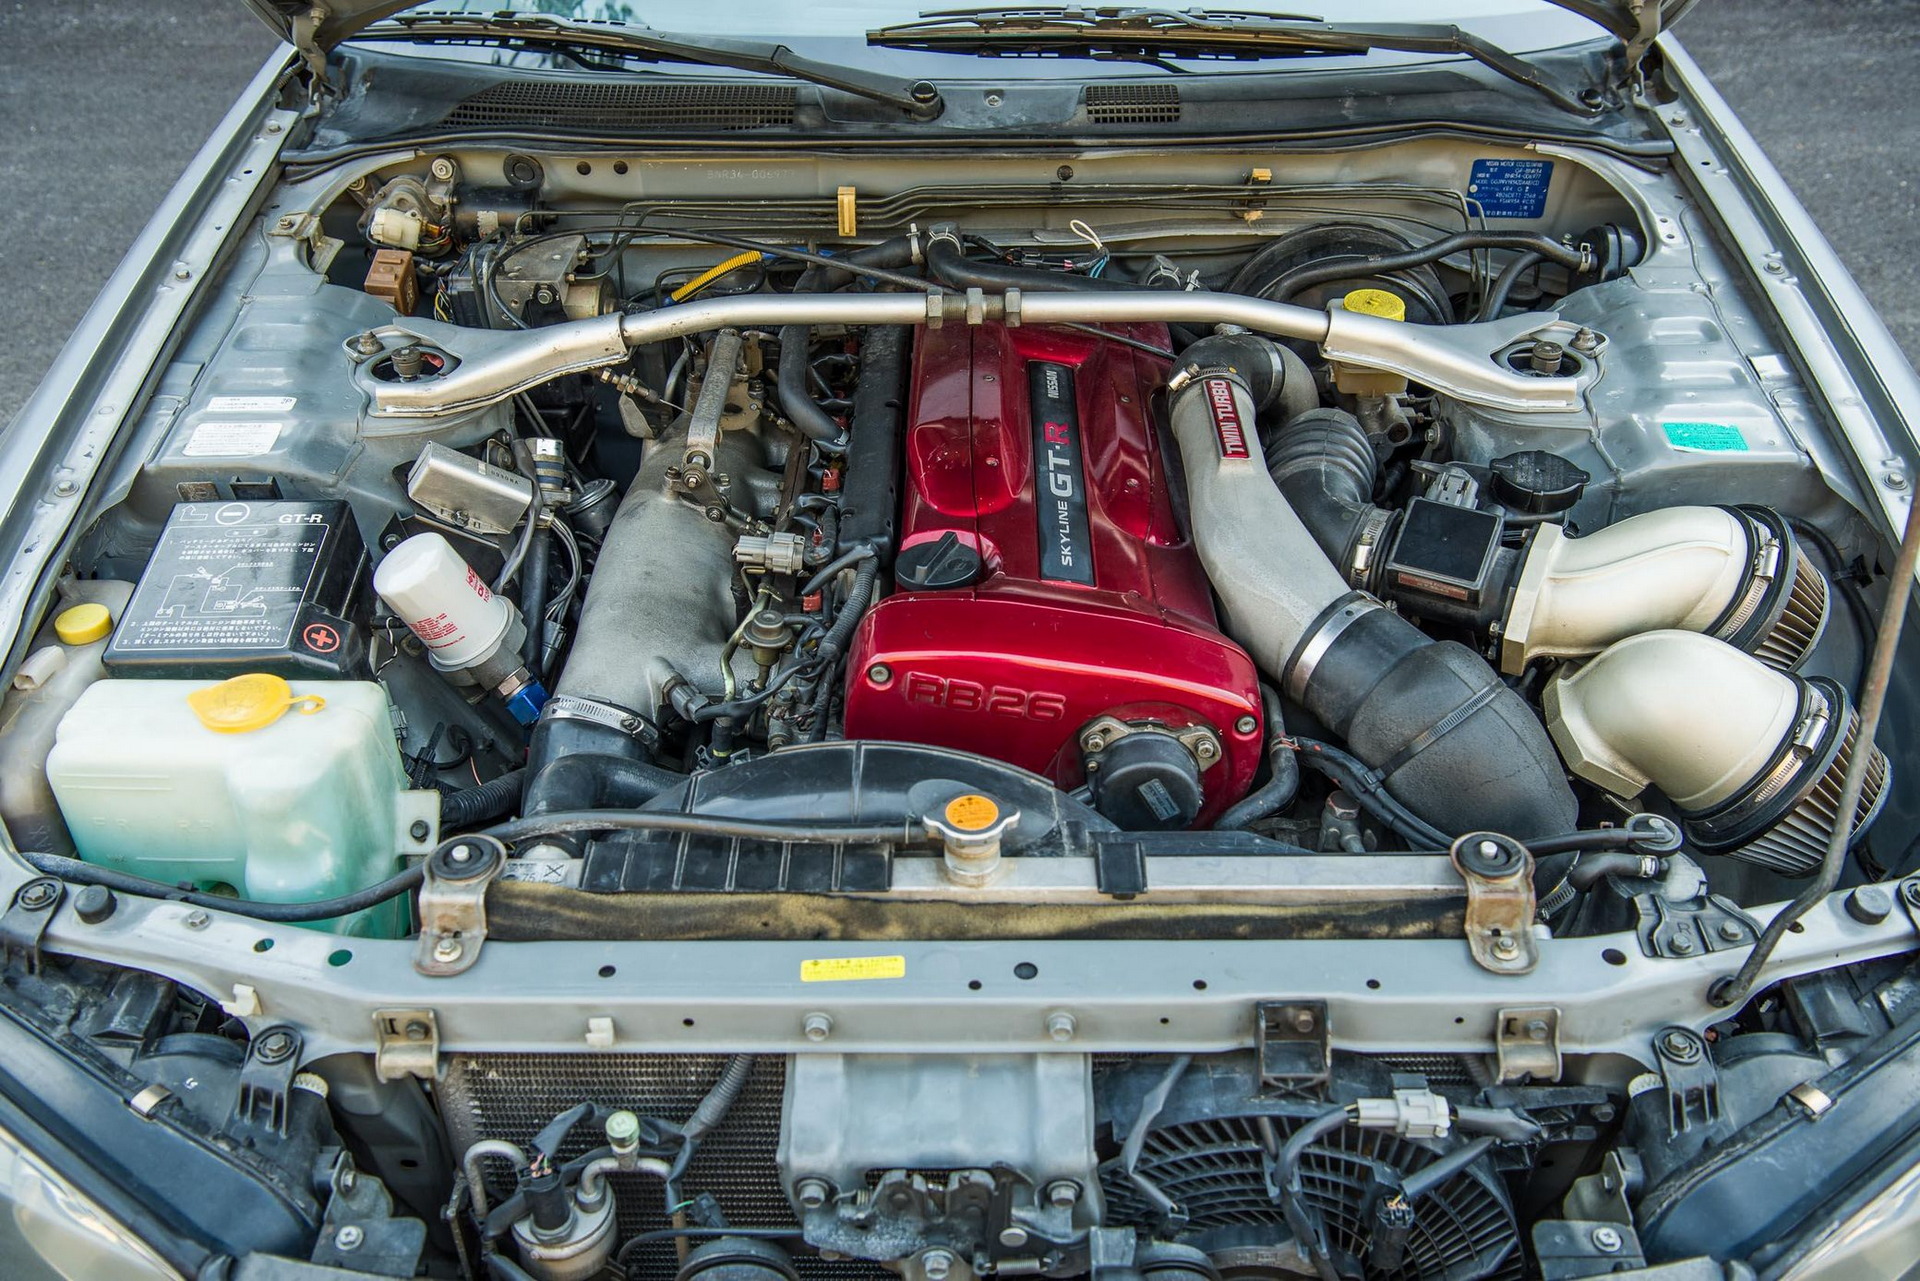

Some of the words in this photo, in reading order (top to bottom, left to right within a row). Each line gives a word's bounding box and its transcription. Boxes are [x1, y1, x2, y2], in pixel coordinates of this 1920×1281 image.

[1048, 370, 1060, 399] NISSAN
[1209, 380, 1234, 420] TURBO
[1220, 421, 1245, 454] TWIN
[278, 513, 324, 524] GT-R
[1058, 500, 1073, 567] SKYLINE
